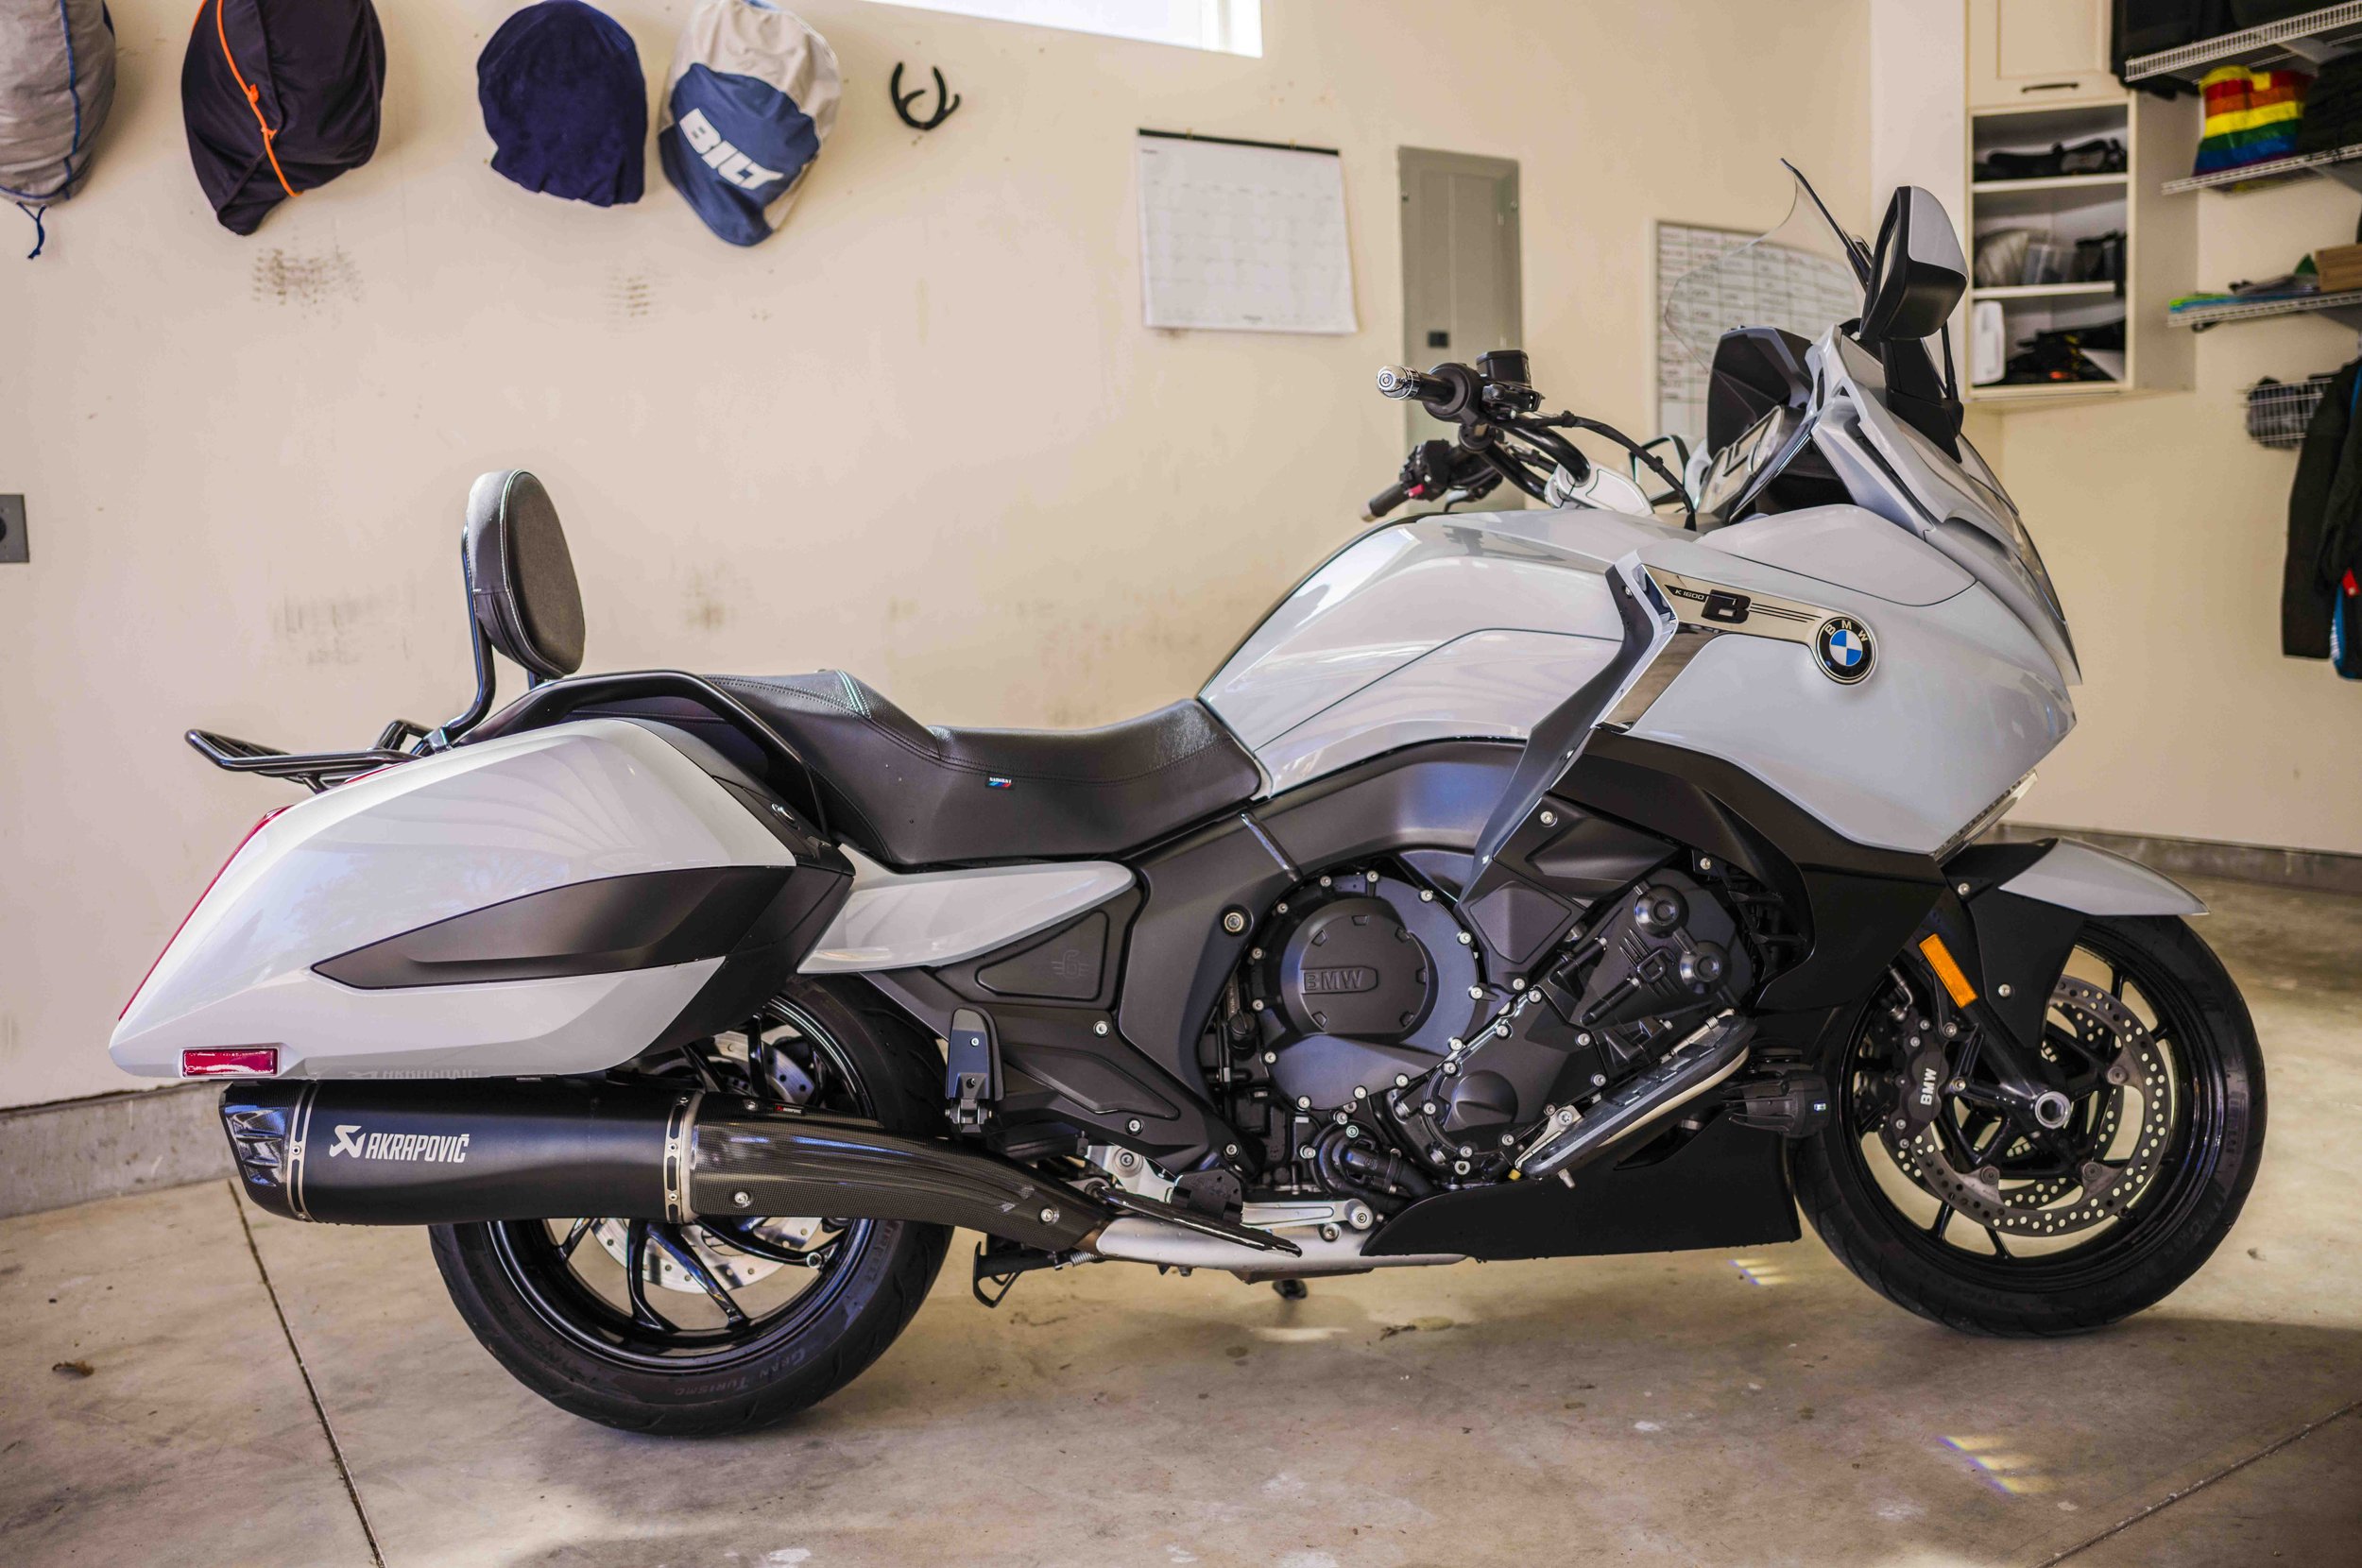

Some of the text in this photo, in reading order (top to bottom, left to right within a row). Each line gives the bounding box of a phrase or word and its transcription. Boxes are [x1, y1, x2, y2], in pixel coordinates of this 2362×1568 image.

[679, 108, 784, 189] BILT
[1824, 620, 1869, 642] BMW
[1303, 970, 1362, 993] BMW
[1920, 1067, 1938, 1106] BMW
